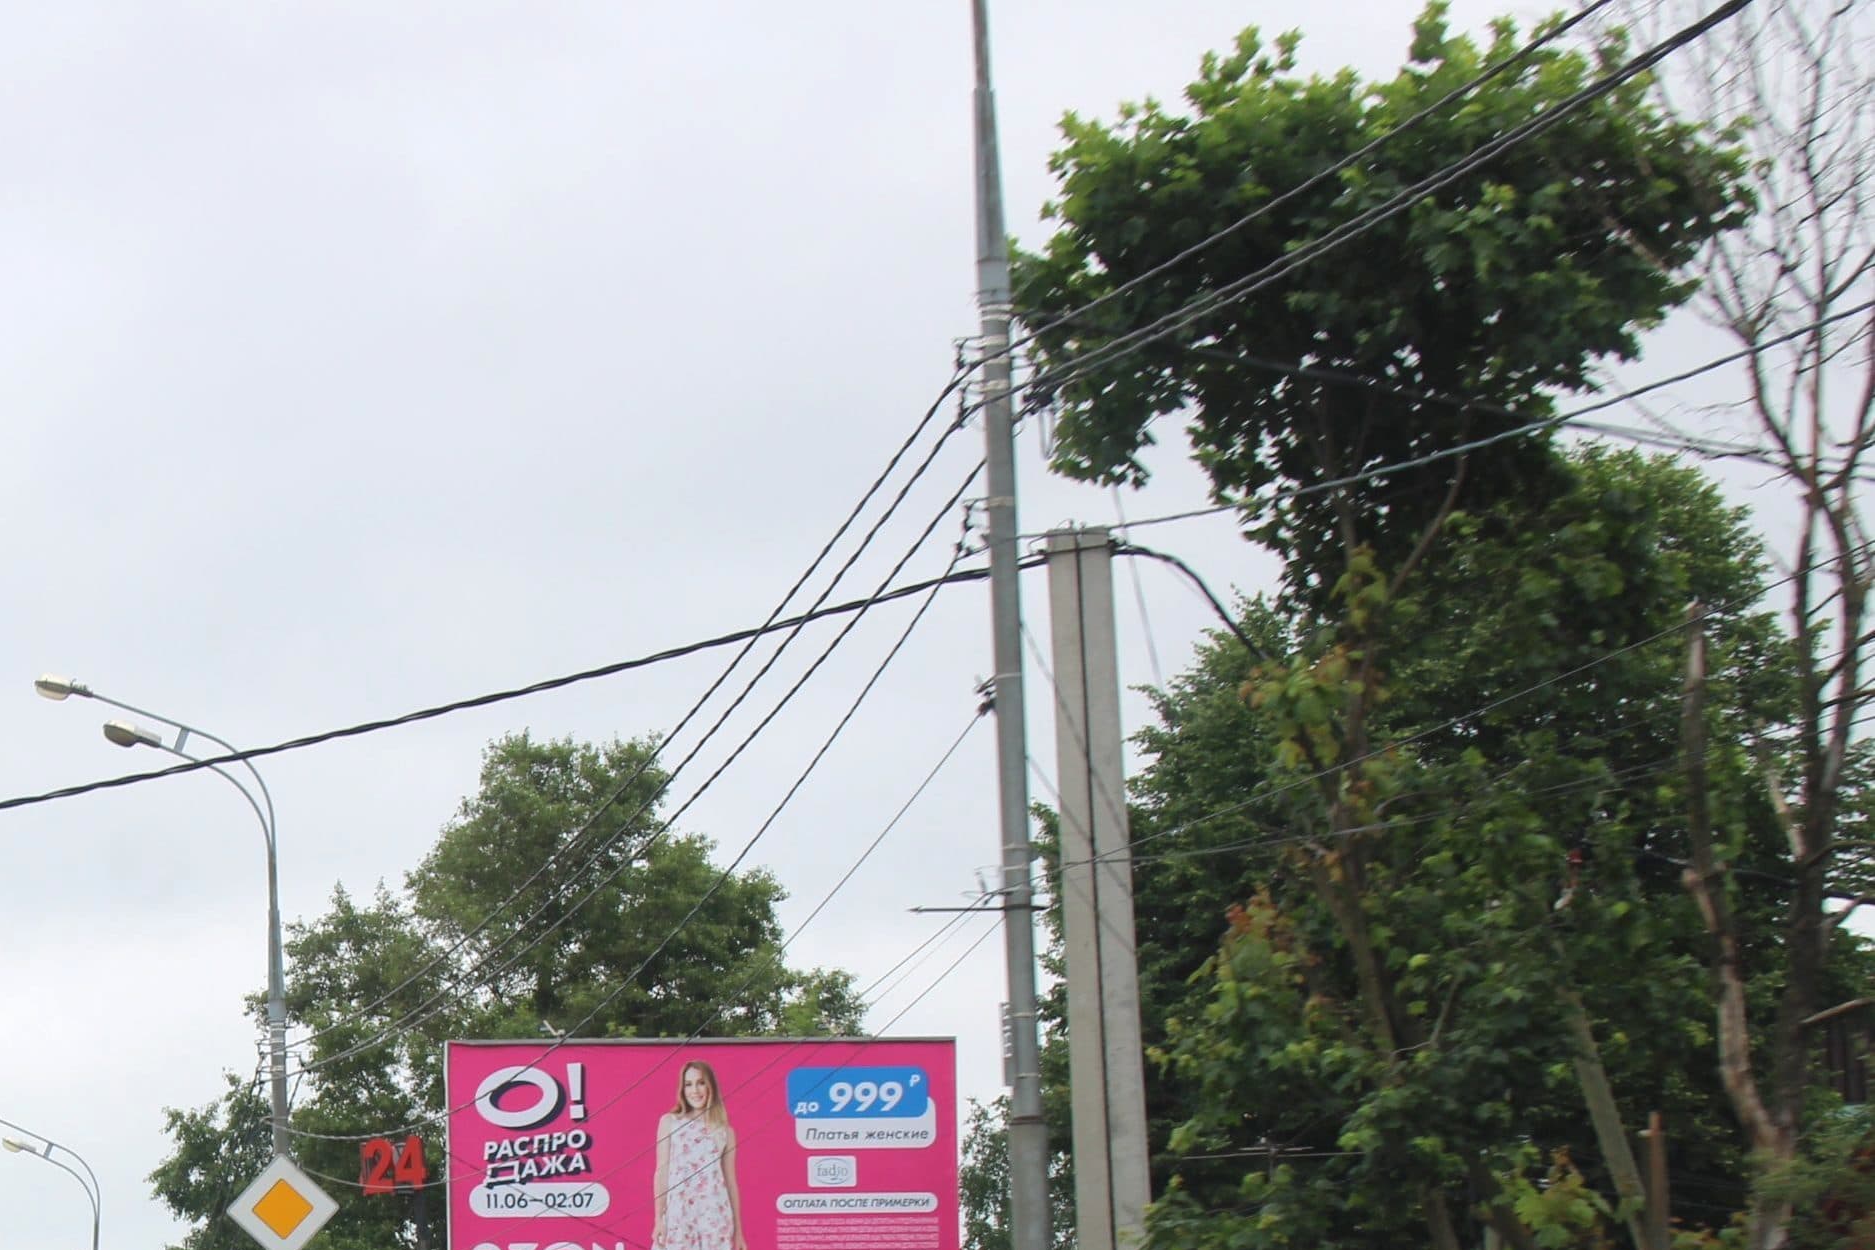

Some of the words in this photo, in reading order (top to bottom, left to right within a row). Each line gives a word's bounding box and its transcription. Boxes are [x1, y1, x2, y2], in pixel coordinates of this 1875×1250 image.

[794, 1102, 820, 1115] до
[829, 1081, 903, 1112] 999
[483, 1129, 587, 1161] РАСПРО
[806, 1128, 859, 1141] Платья
[864, 1129, 929, 1140] женские
[363, 1135, 429, 1196] 24
[482, 1152, 587, 1187] ДАЖА
[783, 1199, 828, 1209] ОПЛАТА
[830, 1198, 867, 1208] ПОСЛЕ
[871, 1197, 930, 1208] ПРИМЕРКИ
